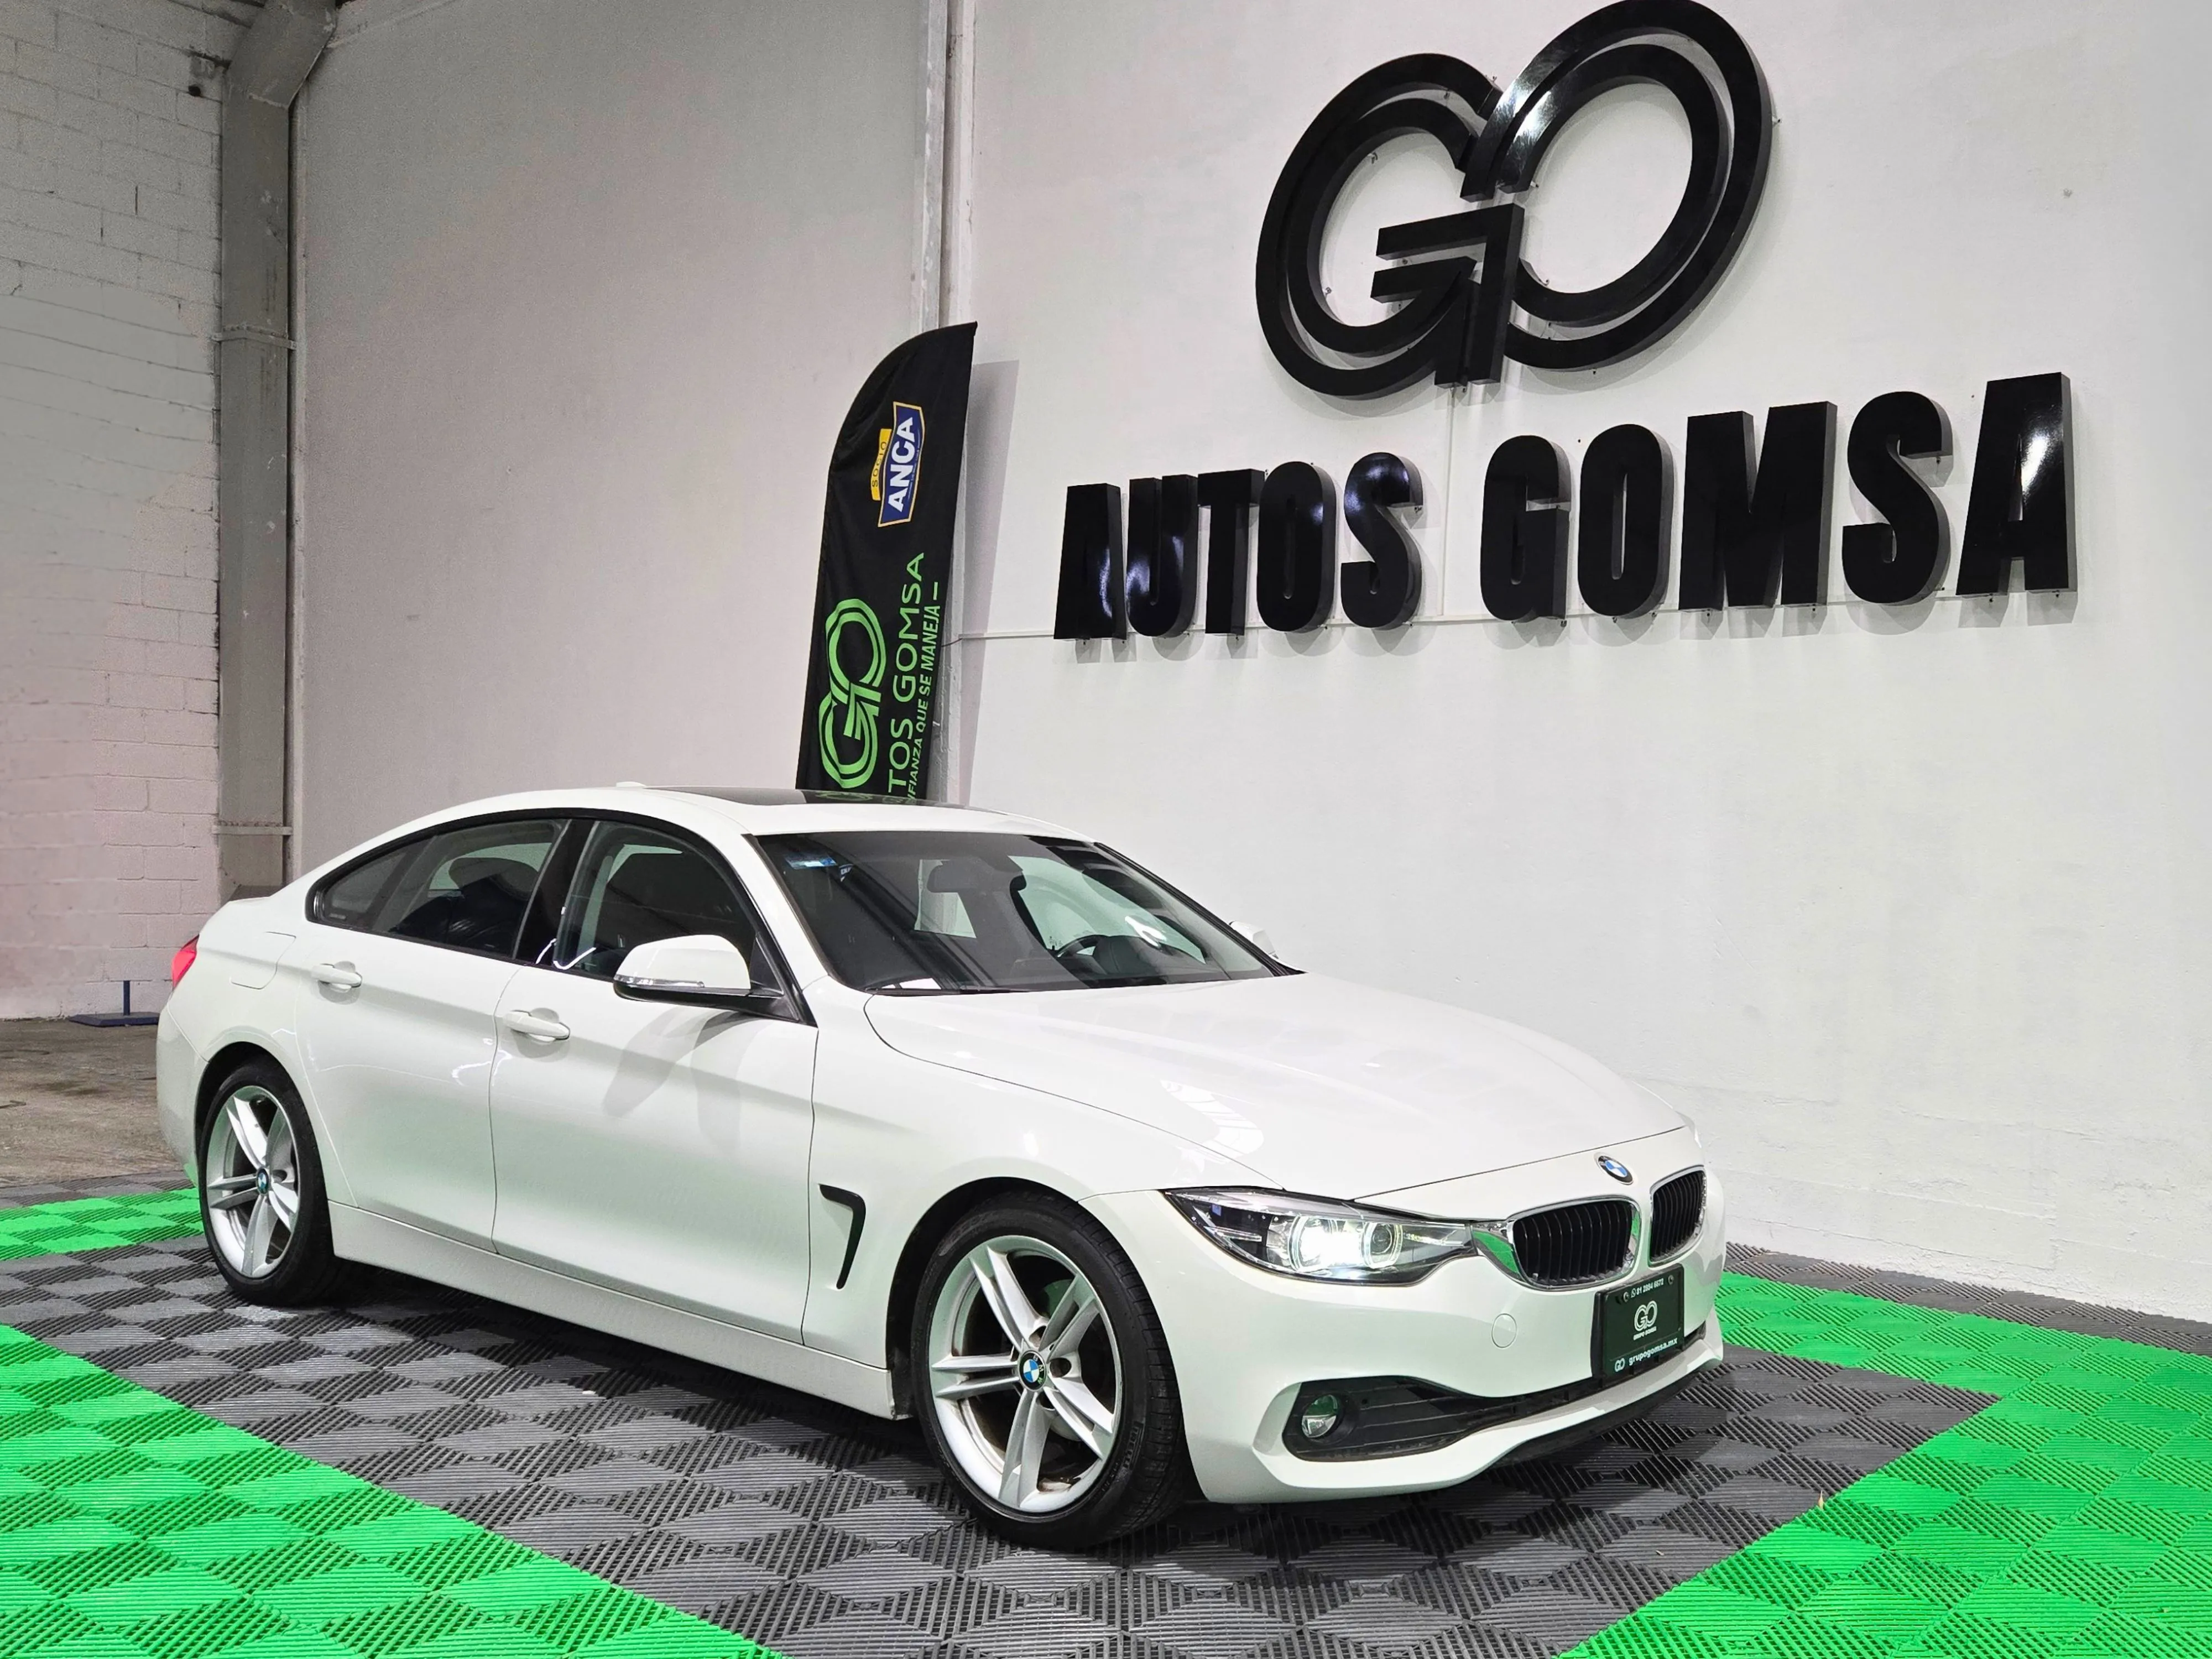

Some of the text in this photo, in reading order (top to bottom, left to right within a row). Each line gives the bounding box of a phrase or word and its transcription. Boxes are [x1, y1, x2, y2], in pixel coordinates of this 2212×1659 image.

[872, 441, 887, 487] SOCIO
[888, 416, 916, 513] ANCA
[1055, 372, 2077, 640] AUTOS GOMSA
[893, 552, 924, 702] GOMSA
[920, 606, 941, 671] MANEJA
[919, 674, 932, 697] SE
[916, 698, 929, 733] QUE
[1629, 1338, 1678, 1366] grupogomsa.mx
